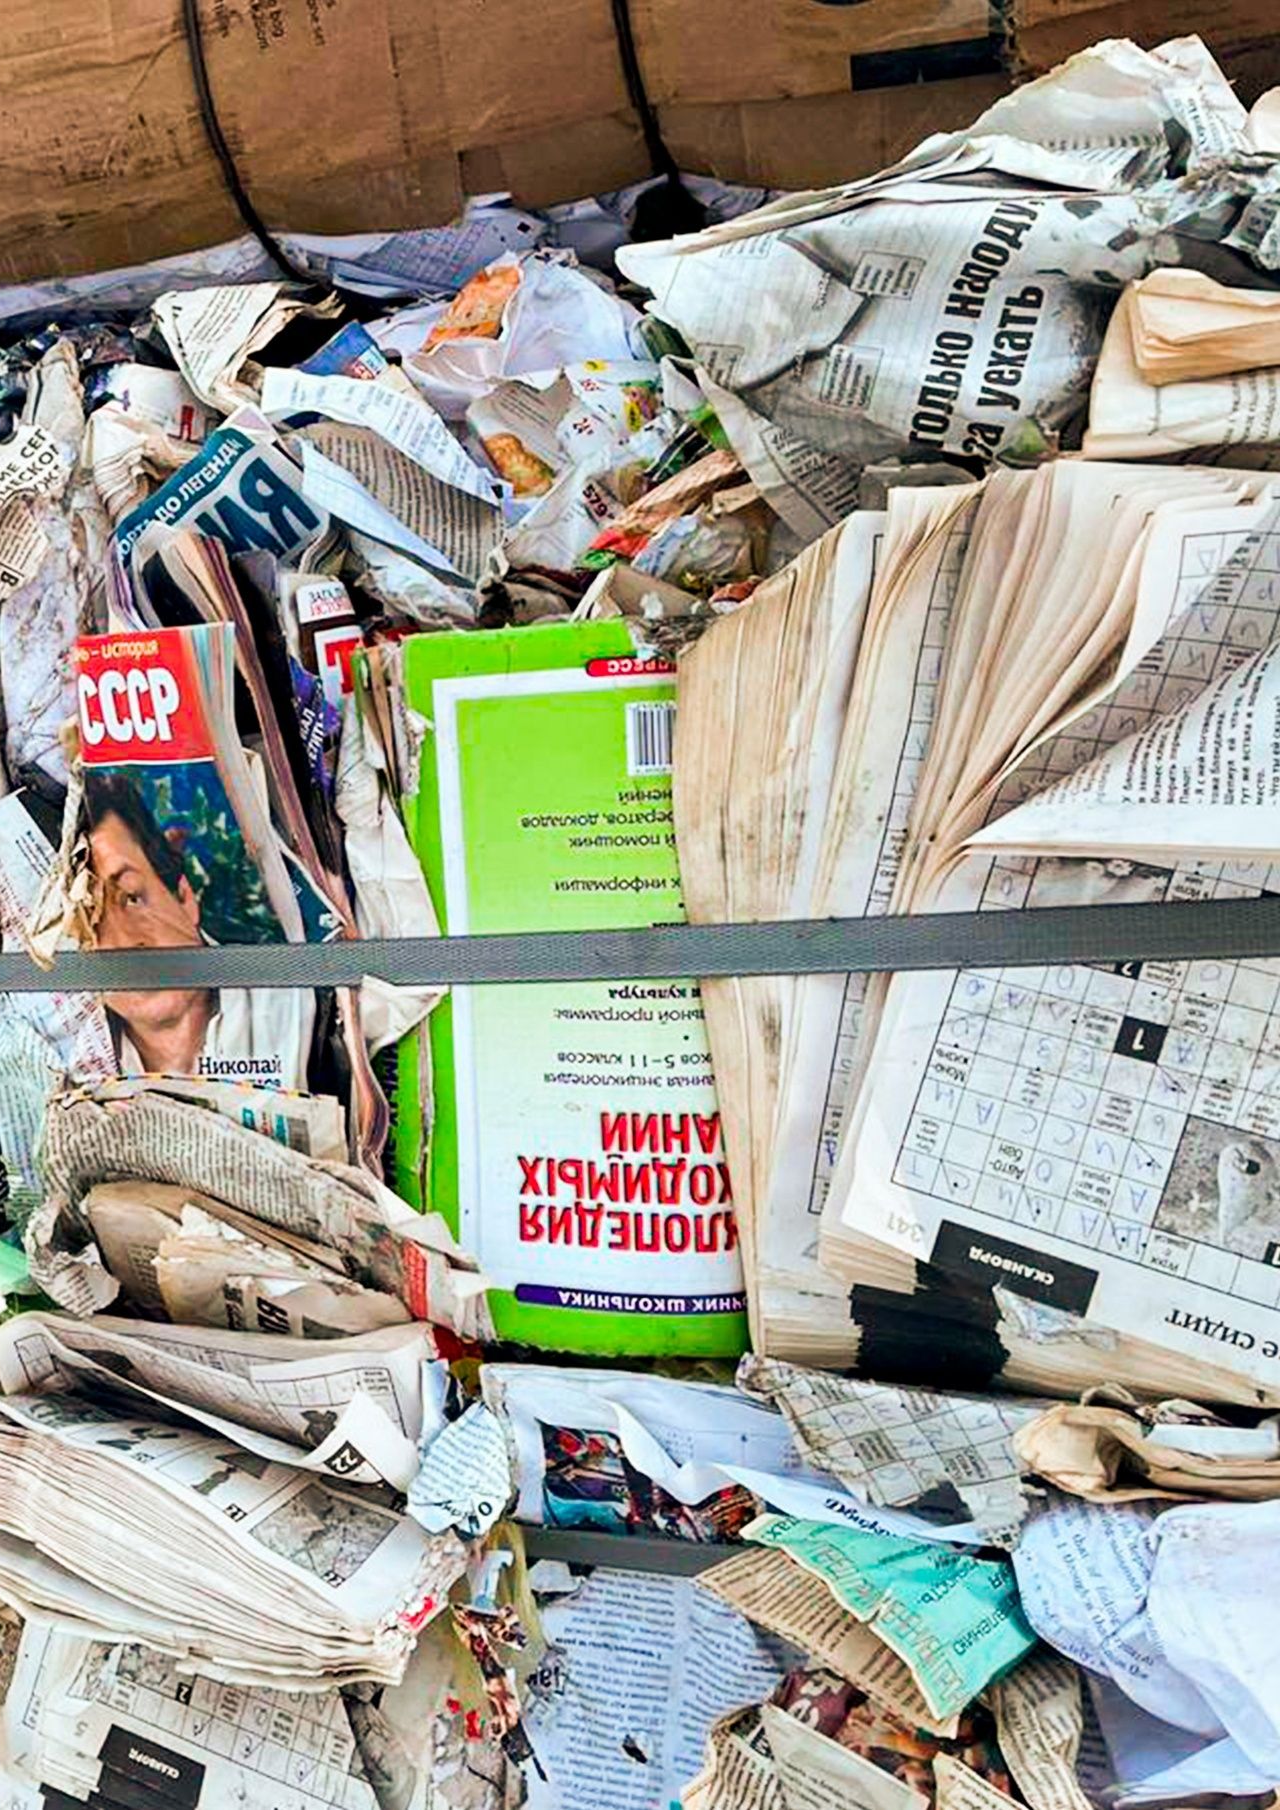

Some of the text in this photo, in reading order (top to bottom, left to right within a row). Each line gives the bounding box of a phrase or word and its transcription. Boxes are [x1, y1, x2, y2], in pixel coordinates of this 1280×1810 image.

[977, 286, 1046, 411] уехать
[80, 667, 180, 746] СССР
[521, 814, 599, 830] докладов
[568, 833, 662, 849] помощник
[554, 876, 667, 894] информации
[198, 1051, 282, 1079] Николай
[557, 1053, 624, 1065] классов
[544, 1073, 662, 1088] энциклопедия
[968, 1246, 1055, 1286] СКАНВОРД
[558, 1290, 686, 1312] ШКОЛЬНИКА
[1165, 1308, 1256, 1352] сидит
